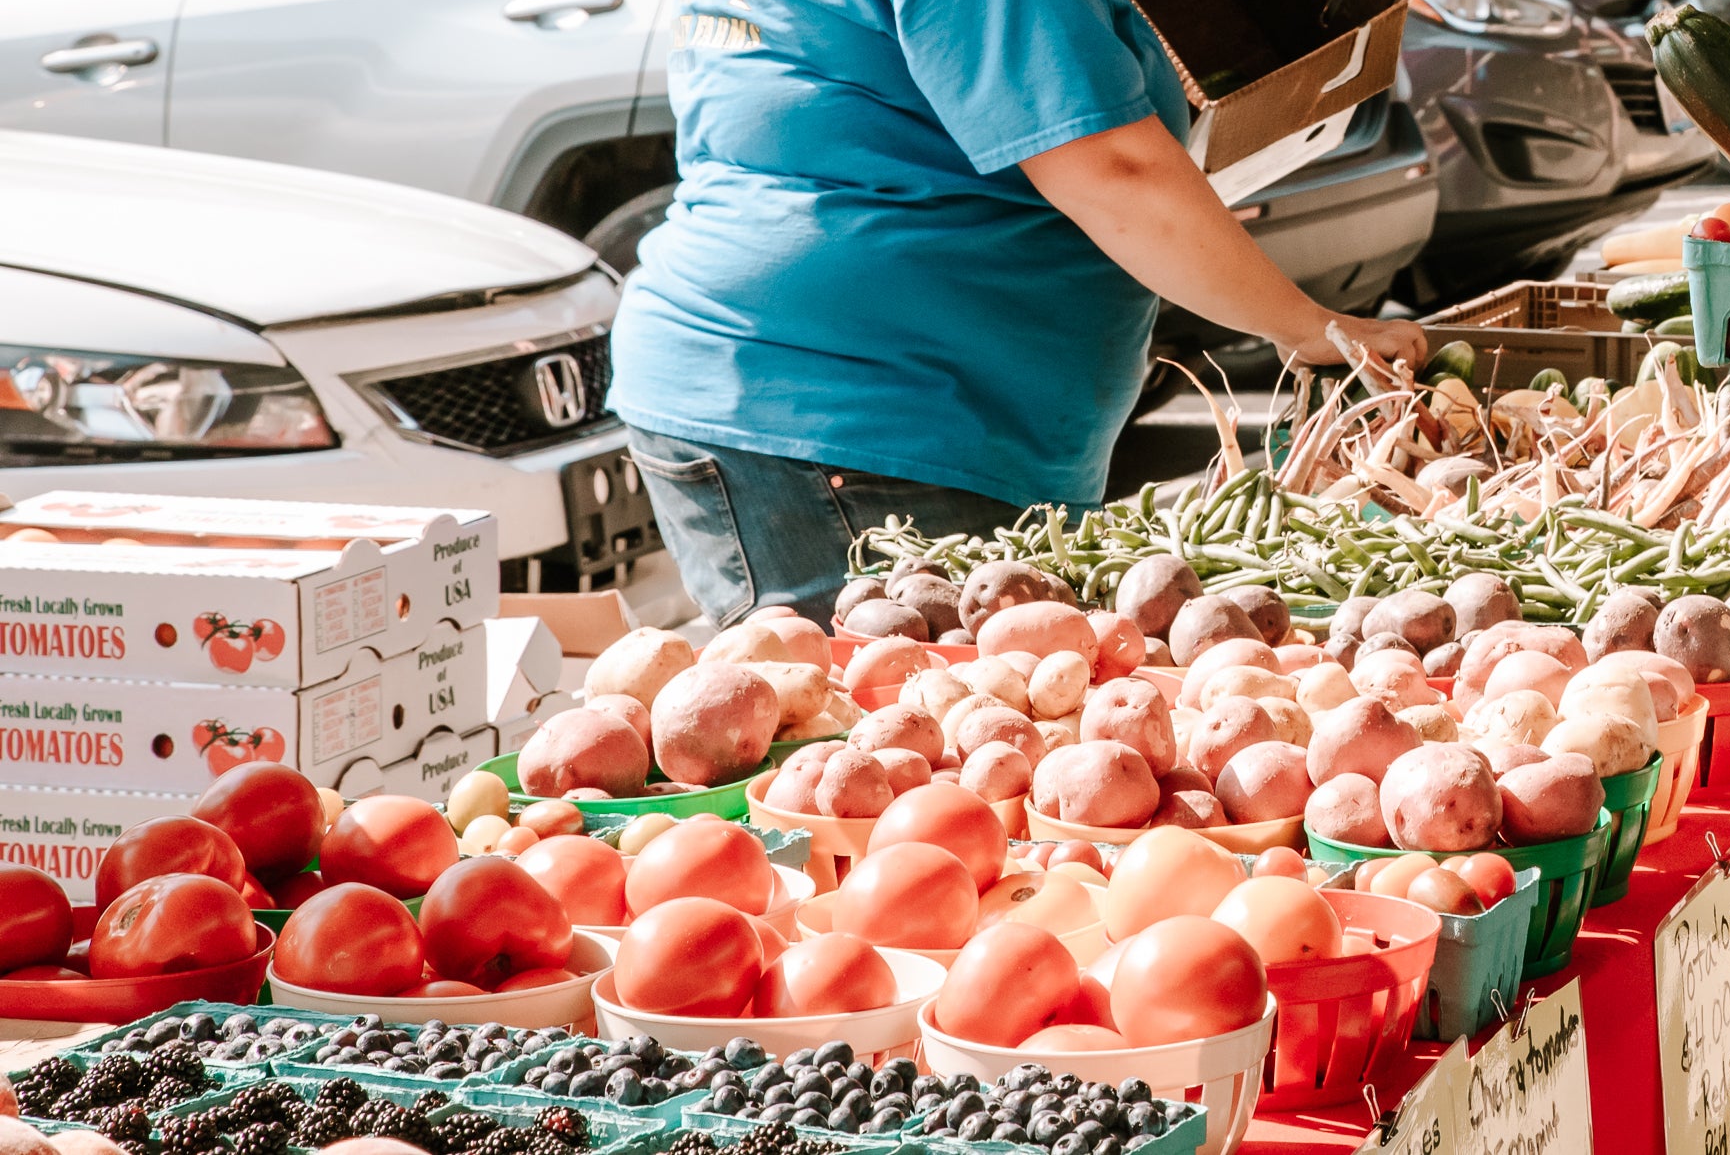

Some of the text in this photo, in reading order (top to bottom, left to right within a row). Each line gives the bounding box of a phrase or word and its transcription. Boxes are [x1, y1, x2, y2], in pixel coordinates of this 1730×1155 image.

[433, 534, 480, 562] Produce
[452, 559, 462, 575] of
[445, 578, 472, 606] USA
[36, 596, 79, 620] Locally
[83, 597, 124, 617] Grown
[0, 622, 126, 660] TOMATOES
[418, 641, 464, 670] Produce
[436, 667, 447, 683] of
[34, 700, 77, 726] Locally
[82, 703, 123, 723] Grown
[428, 685, 455, 715] USA
[422, 751, 469, 781] Produce
[34, 815, 77, 841] Locally
[82, 818, 122, 837] Grown
